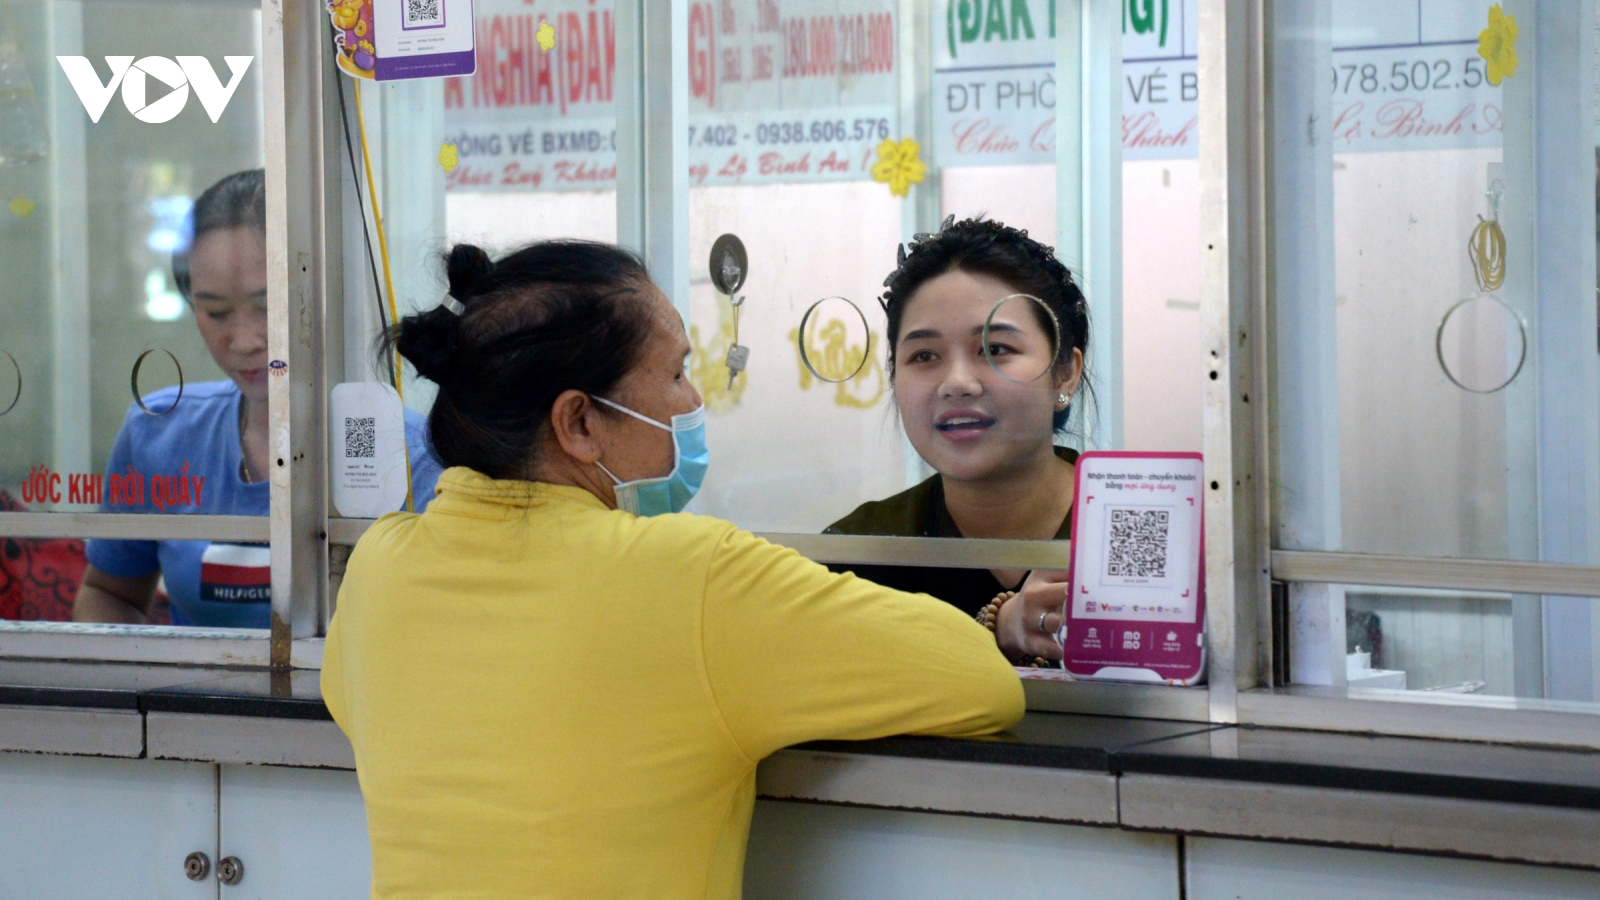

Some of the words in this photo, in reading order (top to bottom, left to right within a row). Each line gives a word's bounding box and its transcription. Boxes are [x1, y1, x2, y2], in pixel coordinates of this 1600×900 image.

[946, 82, 985, 113] ĐT
[1127, 66, 1168, 104] VÉ
[756, 117, 890, 145] 0938.606.576
[68, 474, 103, 505] KHI
[109, 464, 145, 506] RỜI
